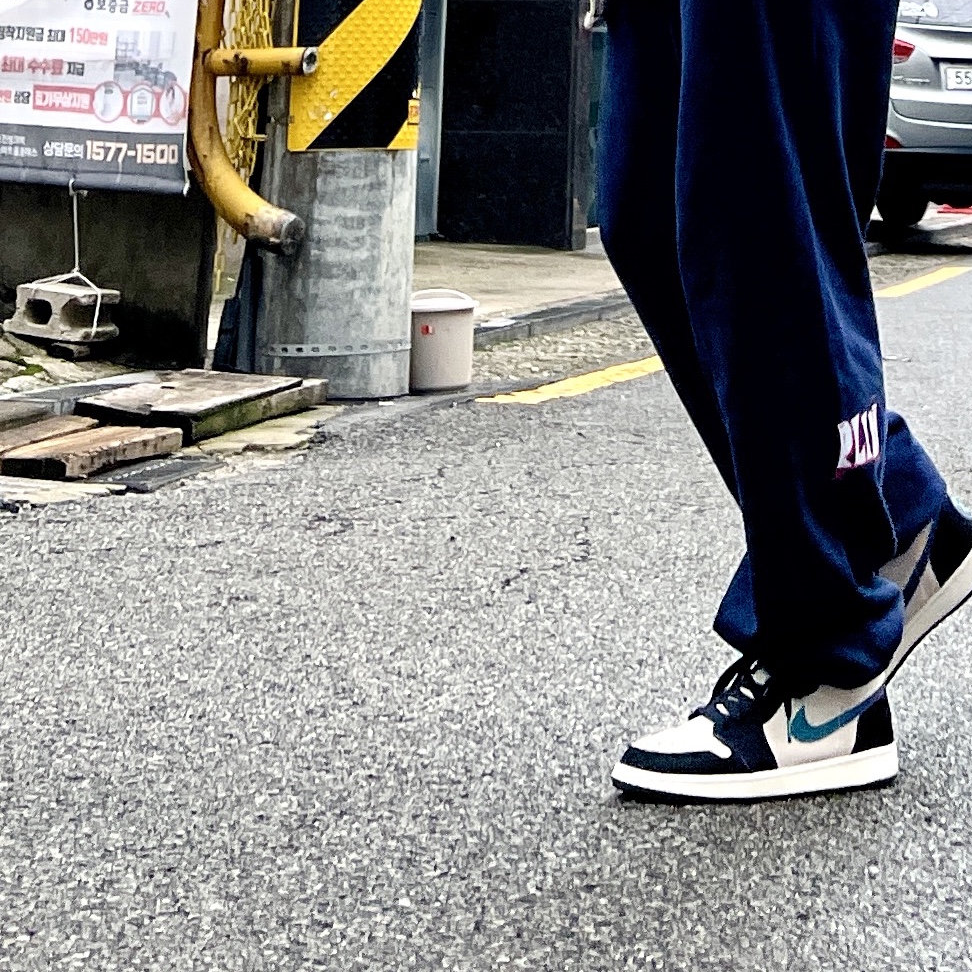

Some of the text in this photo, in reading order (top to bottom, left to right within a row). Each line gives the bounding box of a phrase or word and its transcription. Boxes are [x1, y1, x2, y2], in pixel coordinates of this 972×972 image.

[96, 0, 166, 14] 보증금 ZERO
[43, 140, 84, 159] 상담문의
[85, 139, 179, 165] 1577-1500
